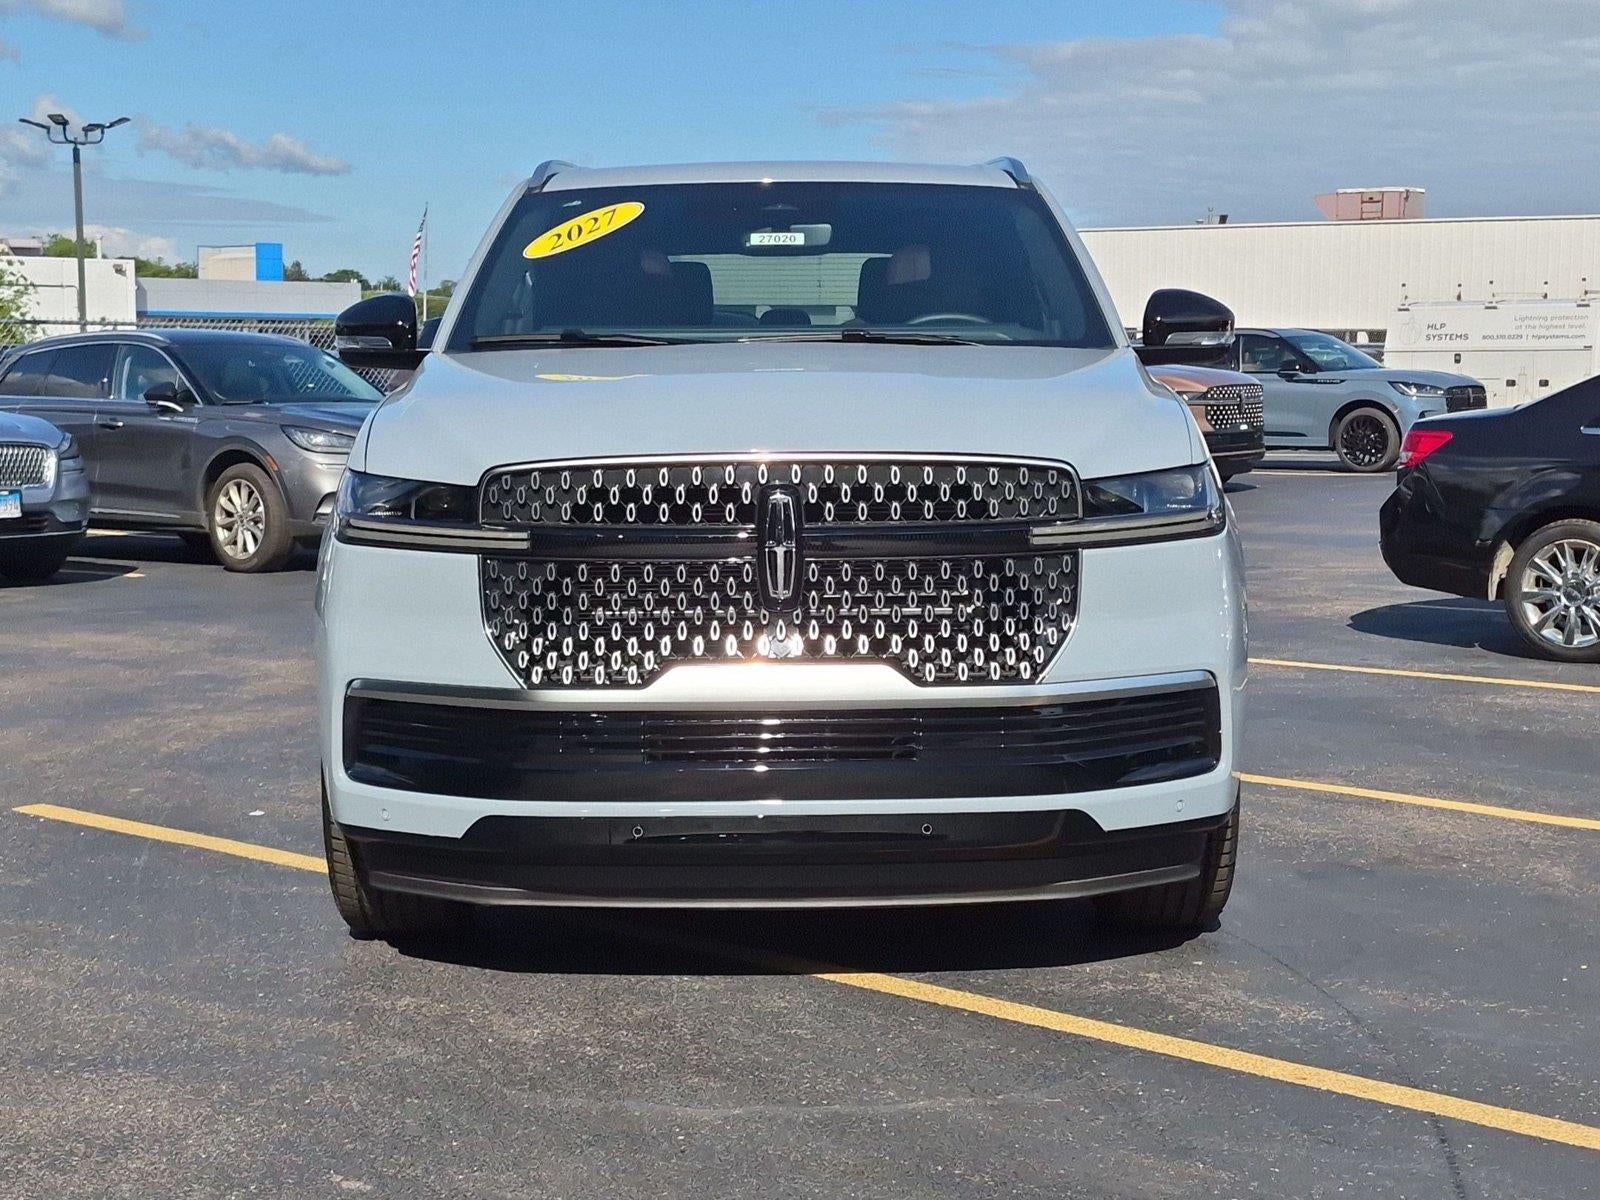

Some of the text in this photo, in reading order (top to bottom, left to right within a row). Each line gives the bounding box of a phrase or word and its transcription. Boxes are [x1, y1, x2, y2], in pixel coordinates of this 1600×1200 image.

[548, 208, 617, 251] 2027
[758, 234, 797, 244] 27020
[1513, 314, 1589, 322] Lightning protection
[1426, 322, 1447, 331] HLP
[1538, 323, 1566, 331] highest
[1425, 332, 1469, 341] SYSTEMS
